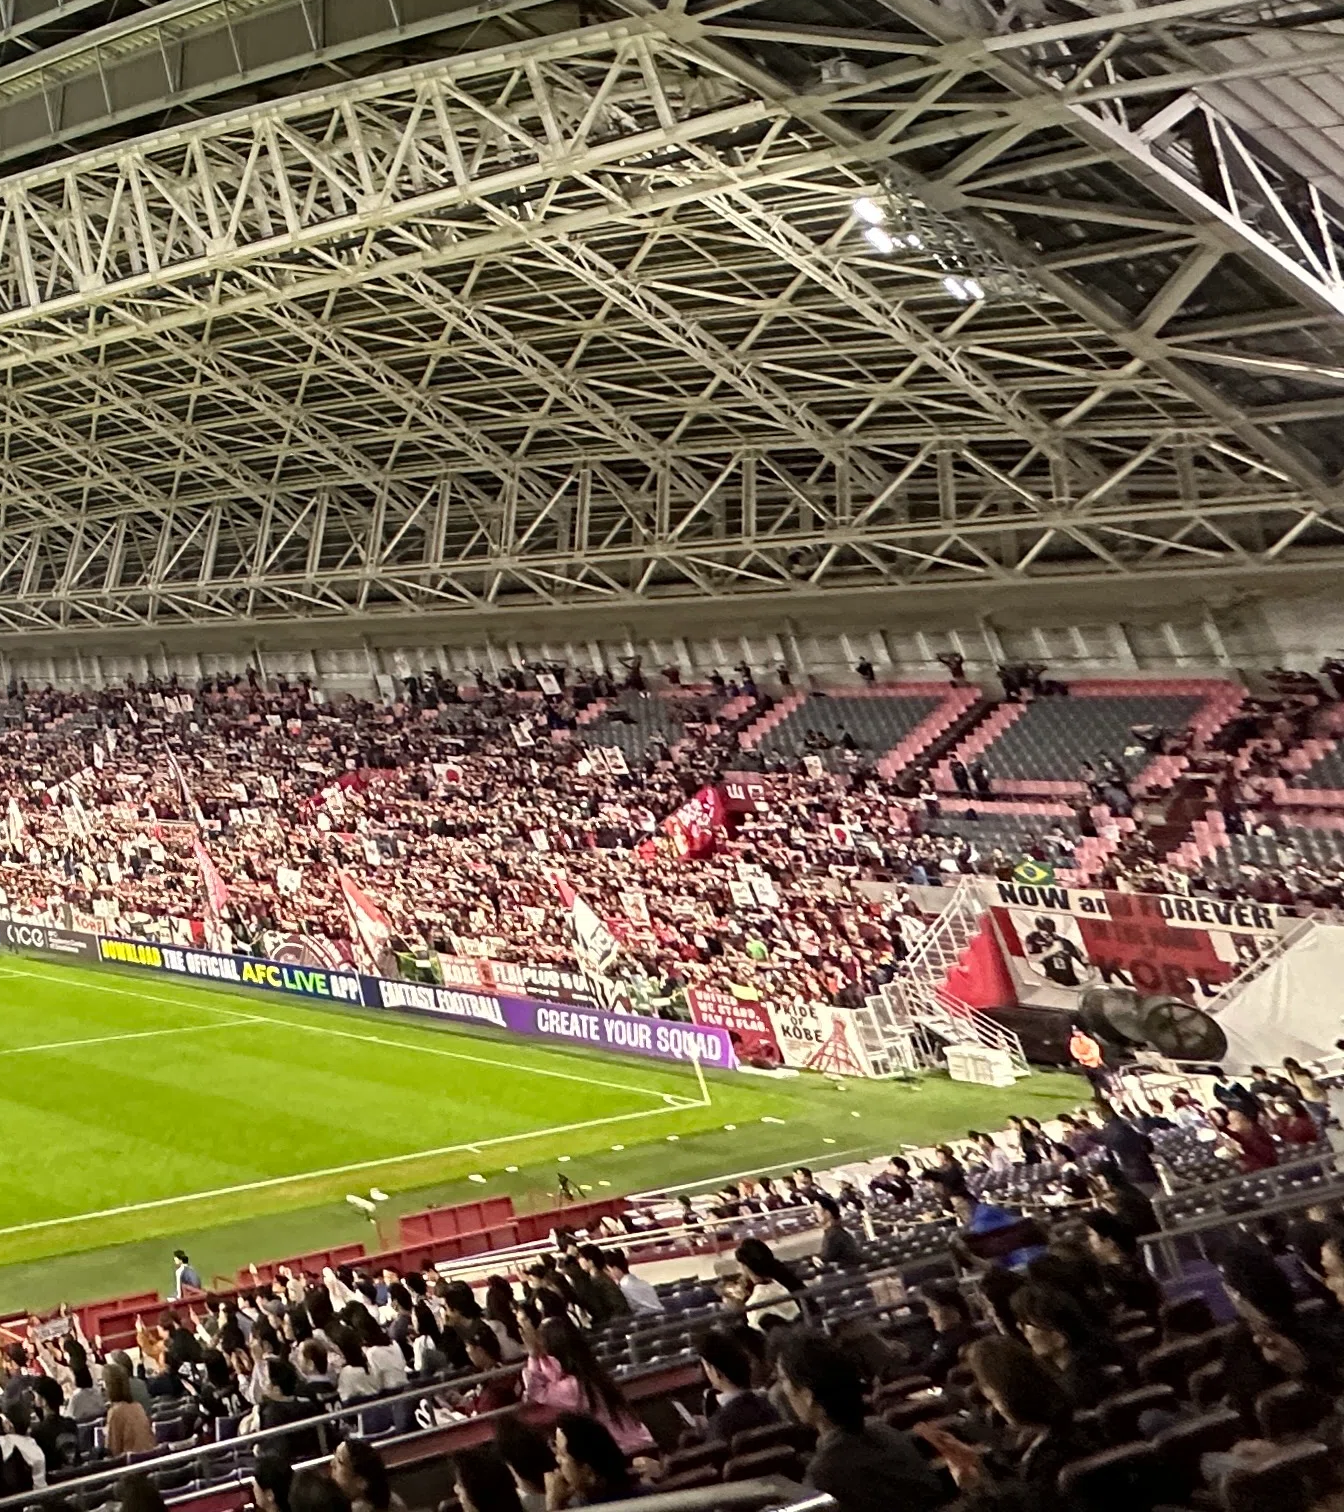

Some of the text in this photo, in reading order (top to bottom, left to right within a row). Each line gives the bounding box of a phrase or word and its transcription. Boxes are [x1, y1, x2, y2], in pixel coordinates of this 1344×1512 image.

[996, 882, 1072, 909] NOW
[74, 913, 103, 933] KOBE
[100, 939, 162, 968] DOWNLOAD
[163, 949, 187, 972] THE
[185, 953, 241, 981] OFFICIAL
[242, 961, 283, 988] AFC
[281, 967, 330, 996] LIVE
[329, 974, 359, 1001] APP
[694, 989, 738, 1007] UNITED
[697, 1001, 716, 1014] WE
[435, 989, 508, 1028] FOOTBALL
[774, 1003, 819, 1020] PRIDE
[790, 1015, 804, 1026] OF
[537, 1007, 722, 1061] CREATE YOUR SQUAD
[781, 1024, 825, 1043] KOBE
